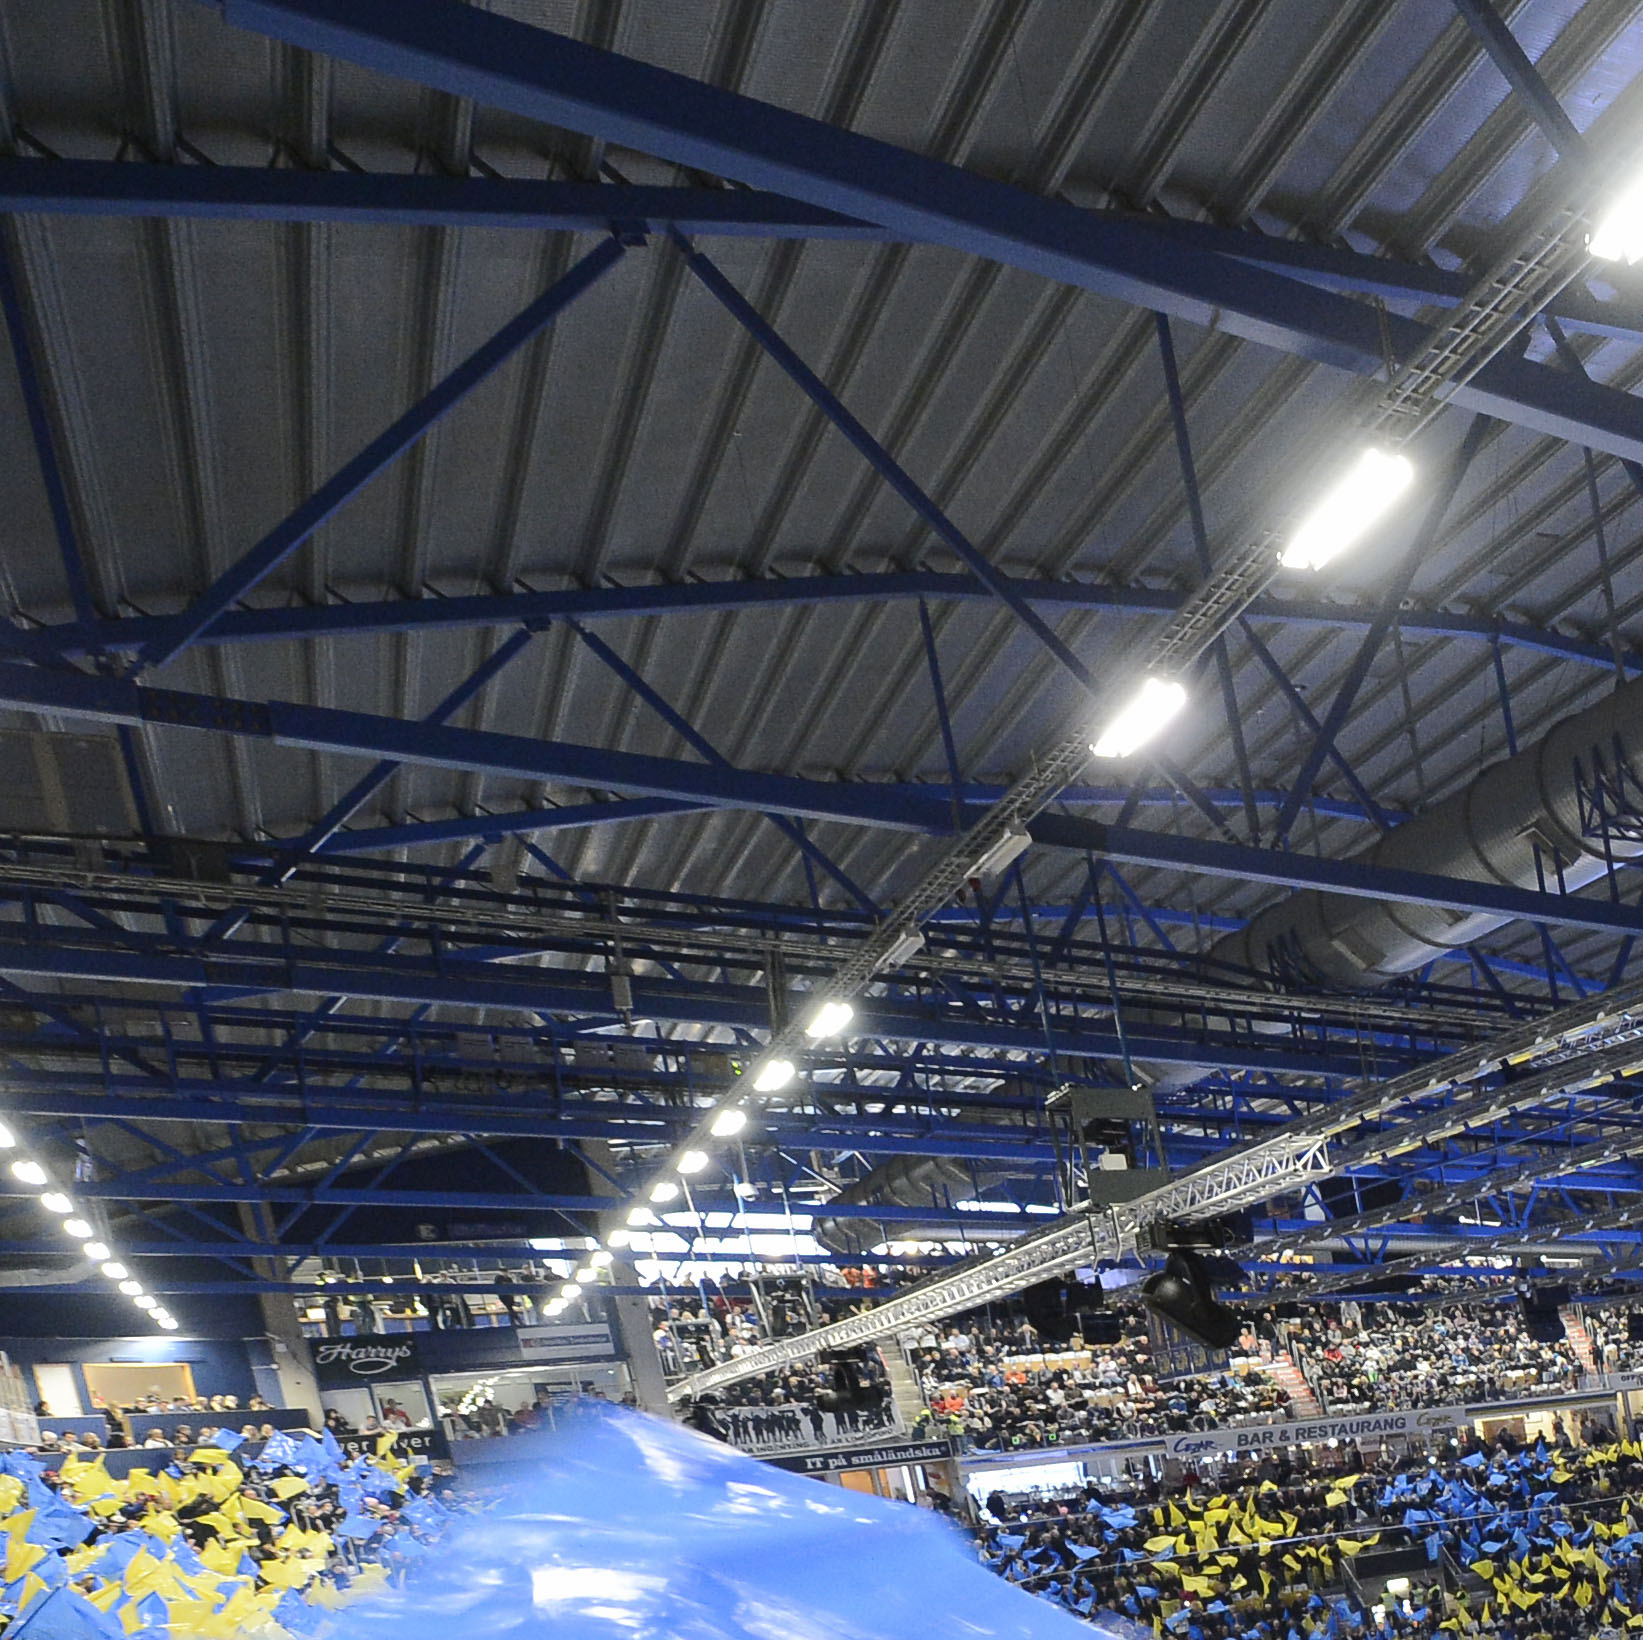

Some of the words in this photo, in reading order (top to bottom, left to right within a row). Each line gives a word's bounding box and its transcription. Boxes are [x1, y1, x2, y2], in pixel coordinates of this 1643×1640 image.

[315, 1342, 412, 1374] Harrys
[1237, 1431, 1274, 1447] BAR
[1279, 1429, 1291, 1441] &
[1295, 1416, 1407, 1441] RESTAURANG
[805, 1458, 824, 1470] IT
[827, 1455, 847, 1470] på
[851, 1446, 941, 1466] småländska
